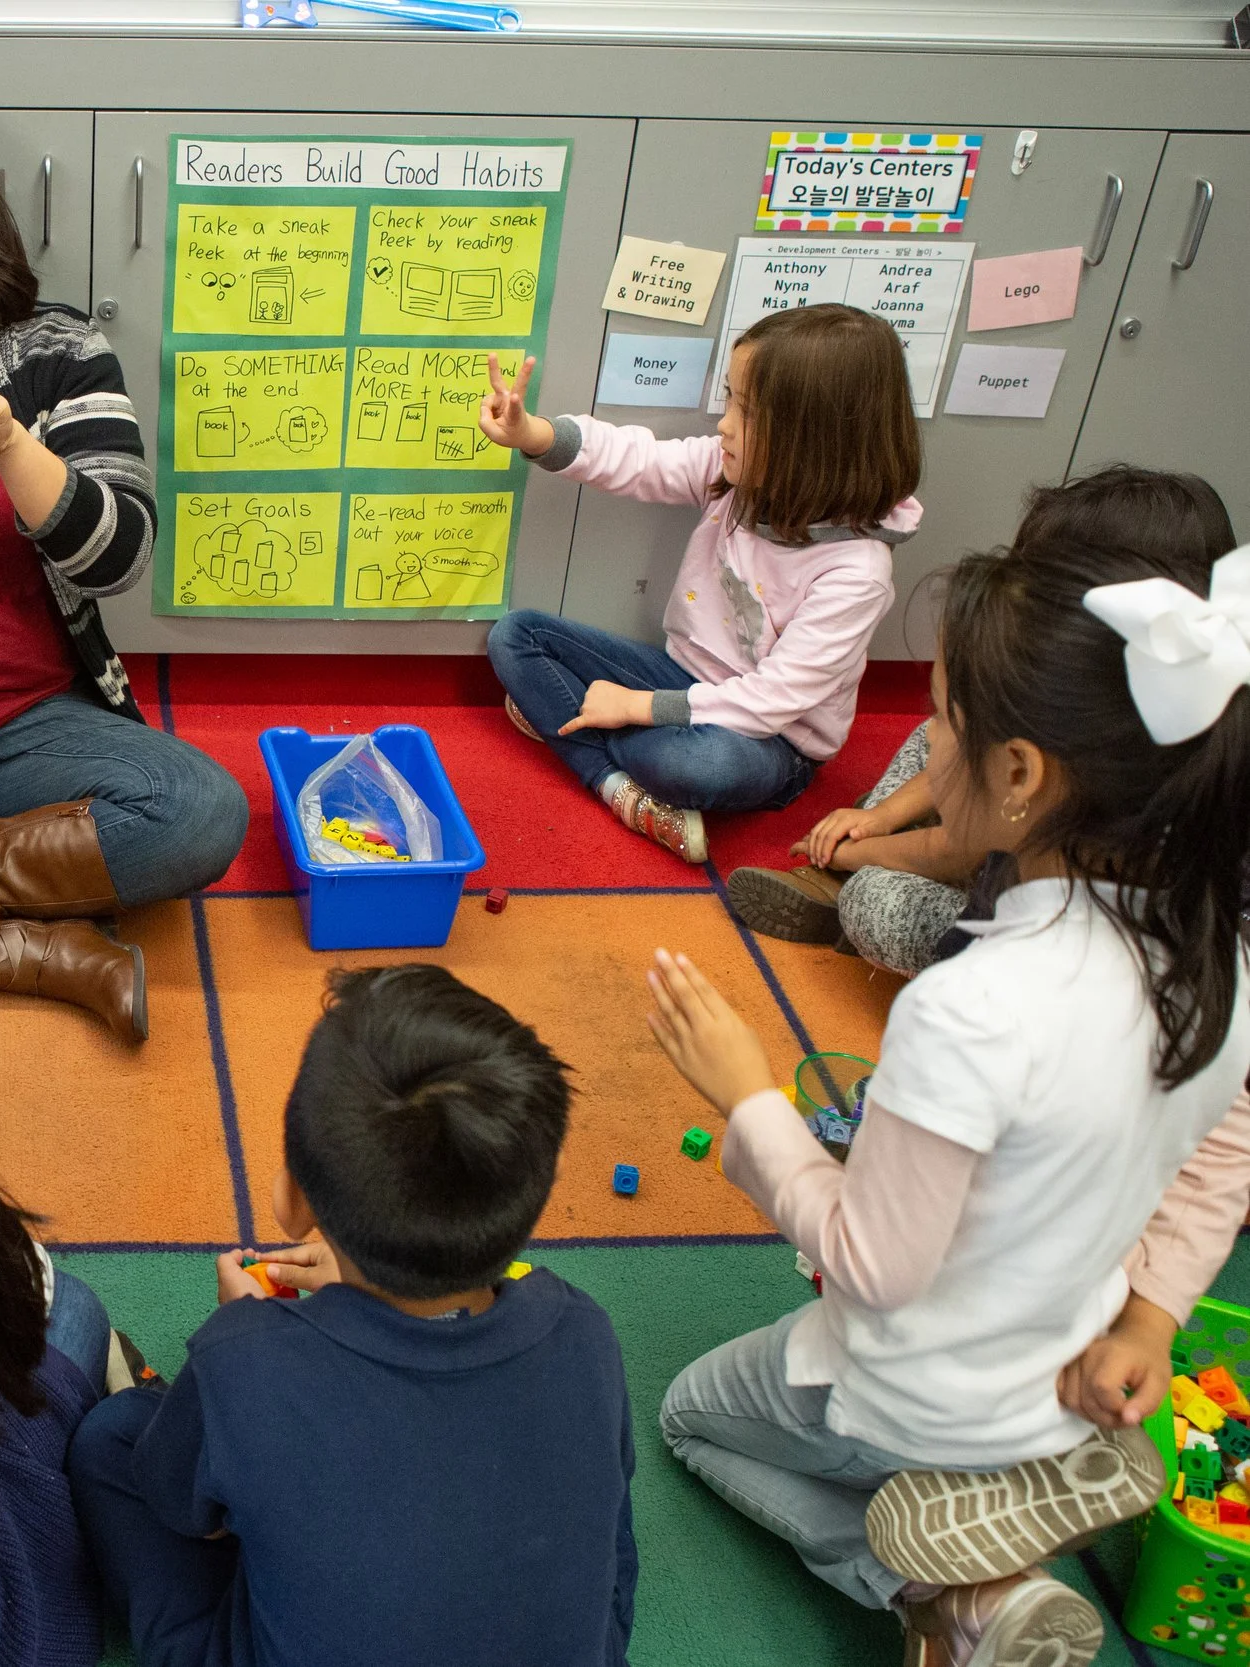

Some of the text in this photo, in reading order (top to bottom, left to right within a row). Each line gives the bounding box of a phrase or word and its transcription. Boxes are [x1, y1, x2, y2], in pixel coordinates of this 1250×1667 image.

[186, 144, 544, 189] Readers Build Good Habits
[784, 157, 953, 179] Today's Centers
[788, 185, 934, 208] 오늘의 발달놀이
[188, 215, 331, 236] Take a sneak
[372, 210, 425, 230] Check
[490, 213, 538, 227] sneak
[379, 231, 416, 248] Peek
[427, 234, 443, 253] by
[777, 245, 836, 255] Development
[841, 246, 880, 255] Centers
[188, 242, 349, 267] Peek at the beginning
[650, 255, 685, 272] Free
[764, 261, 827, 277] Anthony
[879, 264, 933, 277] Andrea
[631, 270, 692, 294] Writing
[774, 279, 810, 294] Nyna
[883, 281, 921, 294] Araf
[617, 286, 695, 313] & Drawing
[1004, 284, 1040, 298] Lego
[762, 297, 789, 309] Mia
[871, 299, 924, 312] Joanna
[181, 354, 344, 377] Do SOMETHING
[356, 348, 517, 379] Read MORE nd
[633, 356, 678, 373] Money
[356, 376, 412, 400] MORE
[634, 373, 669, 386] Game
[978, 374, 1030, 390] Puppet
[192, 382, 211, 398] at
[223, 382, 248, 399] the
[364, 407, 381, 418] book
[405, 411, 422, 421] book
[204, 419, 229, 431] book
[188, 496, 312, 518] Set Goals
[353, 496, 426, 522] Re-read
[434, 500, 453, 516] to
[353, 524, 474, 544] out your voice
[303, 536, 317, 551] 5
